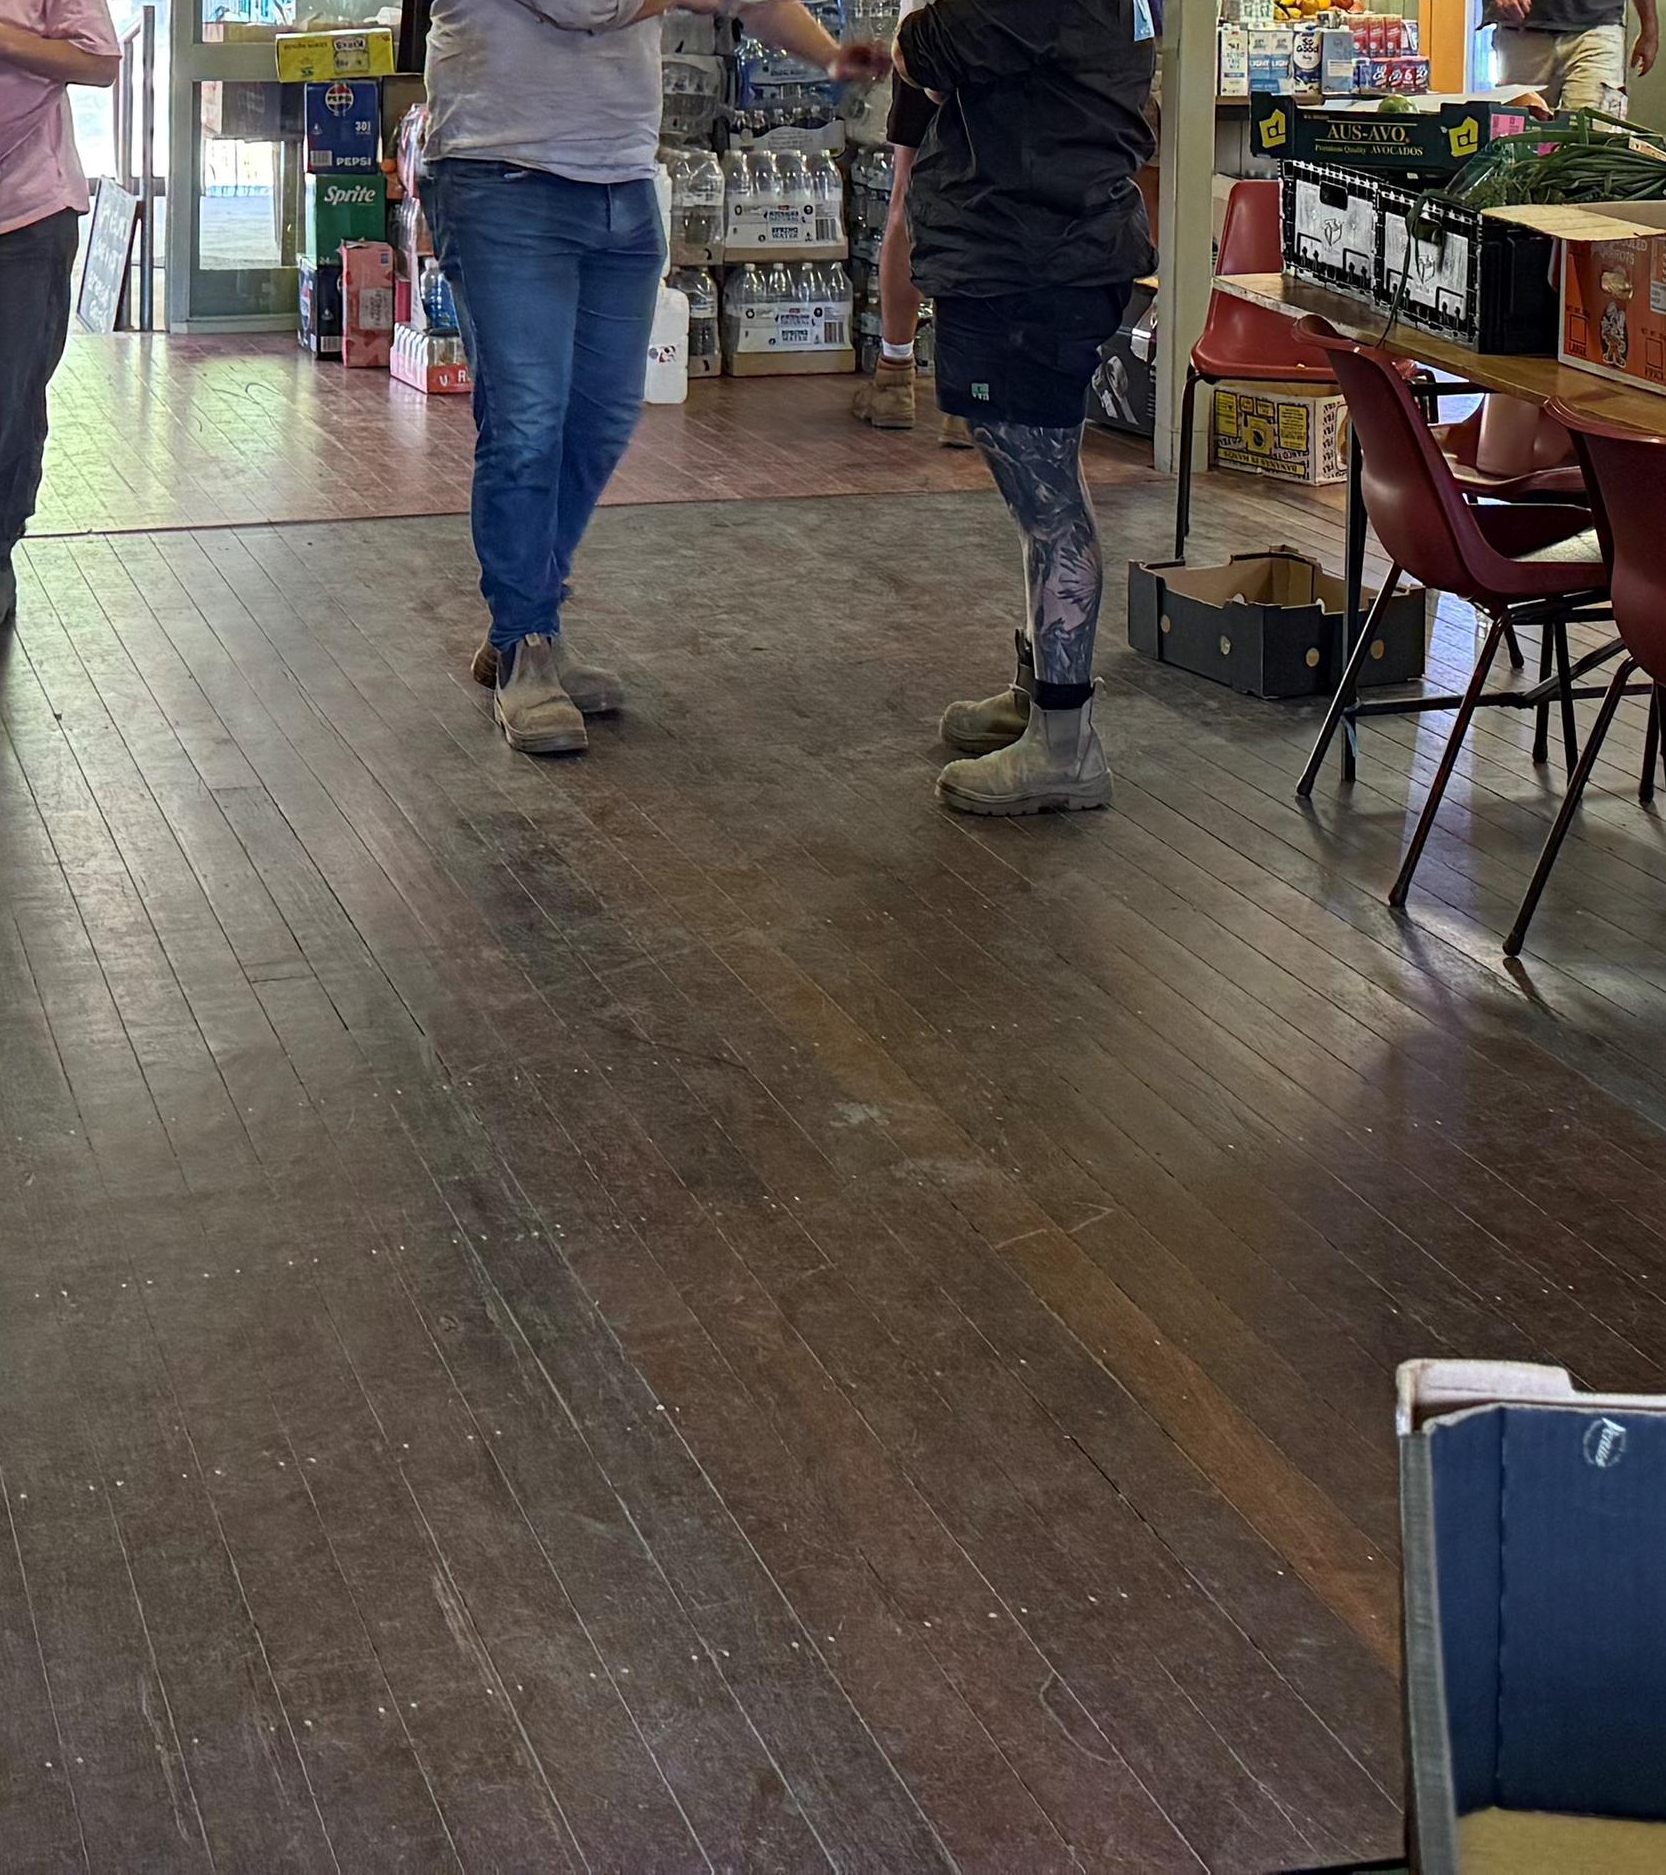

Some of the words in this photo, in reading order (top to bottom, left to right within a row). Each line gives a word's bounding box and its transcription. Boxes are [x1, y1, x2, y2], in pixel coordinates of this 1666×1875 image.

[1327, 124, 1406, 142] AUS-AVO
[1371, 146, 1424, 157] AVOCADOS
[336, 156, 371, 167] PEPSI
[324, 185, 377, 206] Sprite
